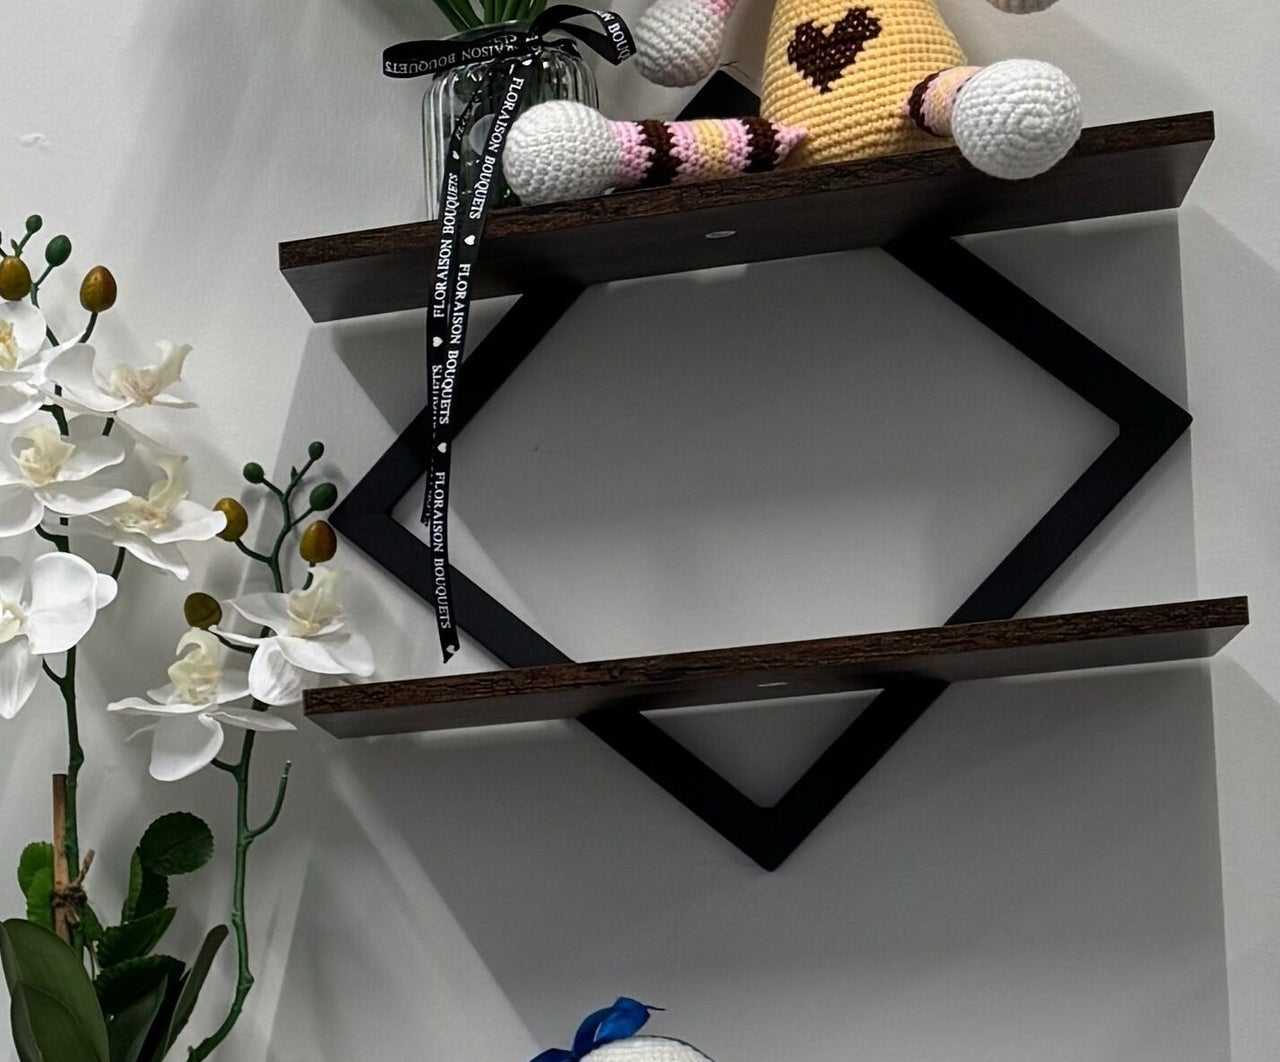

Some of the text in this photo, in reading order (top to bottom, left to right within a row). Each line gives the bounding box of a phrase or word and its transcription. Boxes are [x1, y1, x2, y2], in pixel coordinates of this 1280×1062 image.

[385, 52, 456, 74] BOUQUETS
[433, 173, 458, 318] FLORAISON BOUQUETS
[433, 77, 525, 630] FLORAISON BOUQUETS FLORAISON BOUQUETS FLORAISON BOUQUETS
